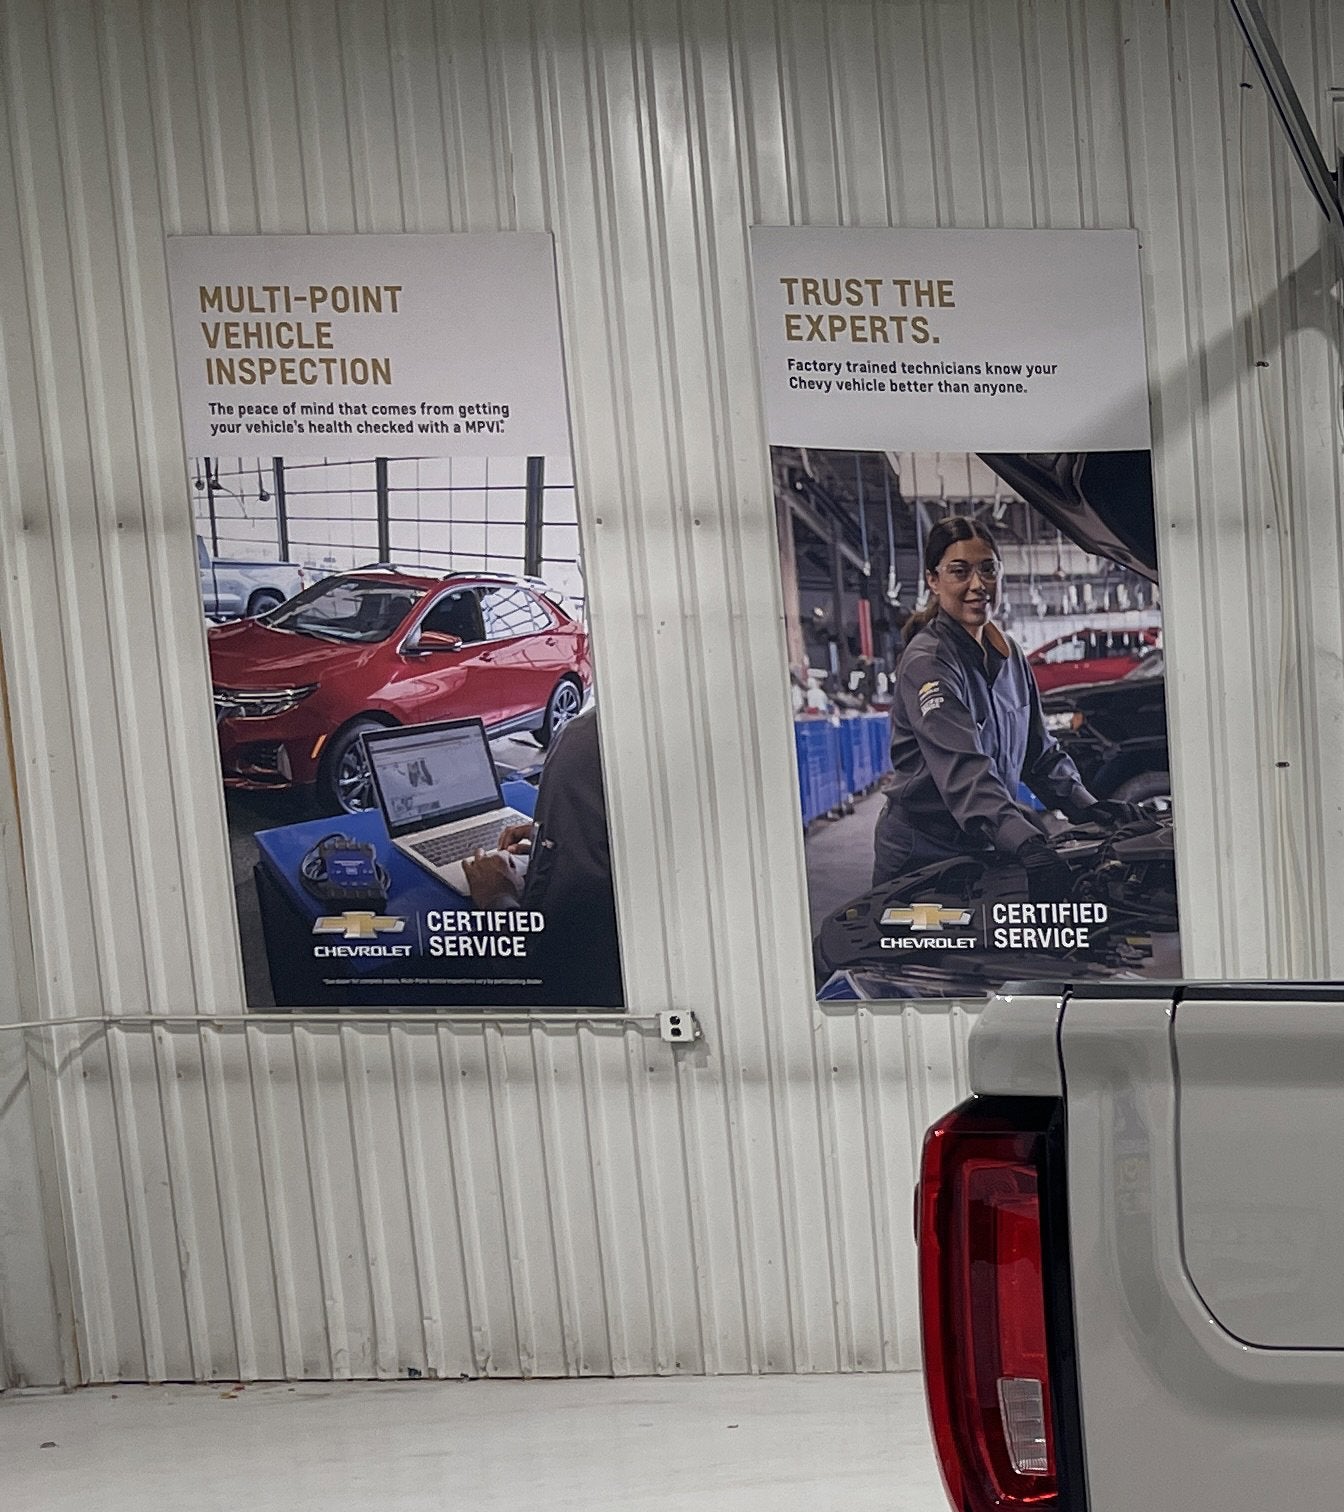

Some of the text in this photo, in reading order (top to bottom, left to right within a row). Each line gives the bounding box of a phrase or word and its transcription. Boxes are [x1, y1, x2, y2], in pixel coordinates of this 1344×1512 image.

[200, 286, 402, 313] MULTI-POINT
[780, 278, 956, 308] TRUST THE
[201, 322, 334, 349] VEHICLE
[785, 314, 940, 344] EXPERTS.
[206, 358, 392, 385] INSPECTION
[787, 359, 1058, 378] Factory trained technicians know your
[789, 376, 1028, 396] Chevy vehicle better than anyone.
[208, 402, 509, 418] The peace of mind that comes from getting
[211, 423, 241, 436] your
[245, 420, 304, 433] vehicle's
[308, 420, 353, 433] health
[356, 420, 413, 433] checked
[418, 421, 449, 433] with
[453, 423, 461, 433] a
[427, 910, 545, 933] CERTIFIED
[992, 903, 1108, 924] CERTIFIED
[429, 936, 527, 957] SERVICE
[880, 937, 977, 949] CHEVROLET
[994, 928, 1090, 948] SERVICE
[313, 945, 412, 957] CHEVROLET
